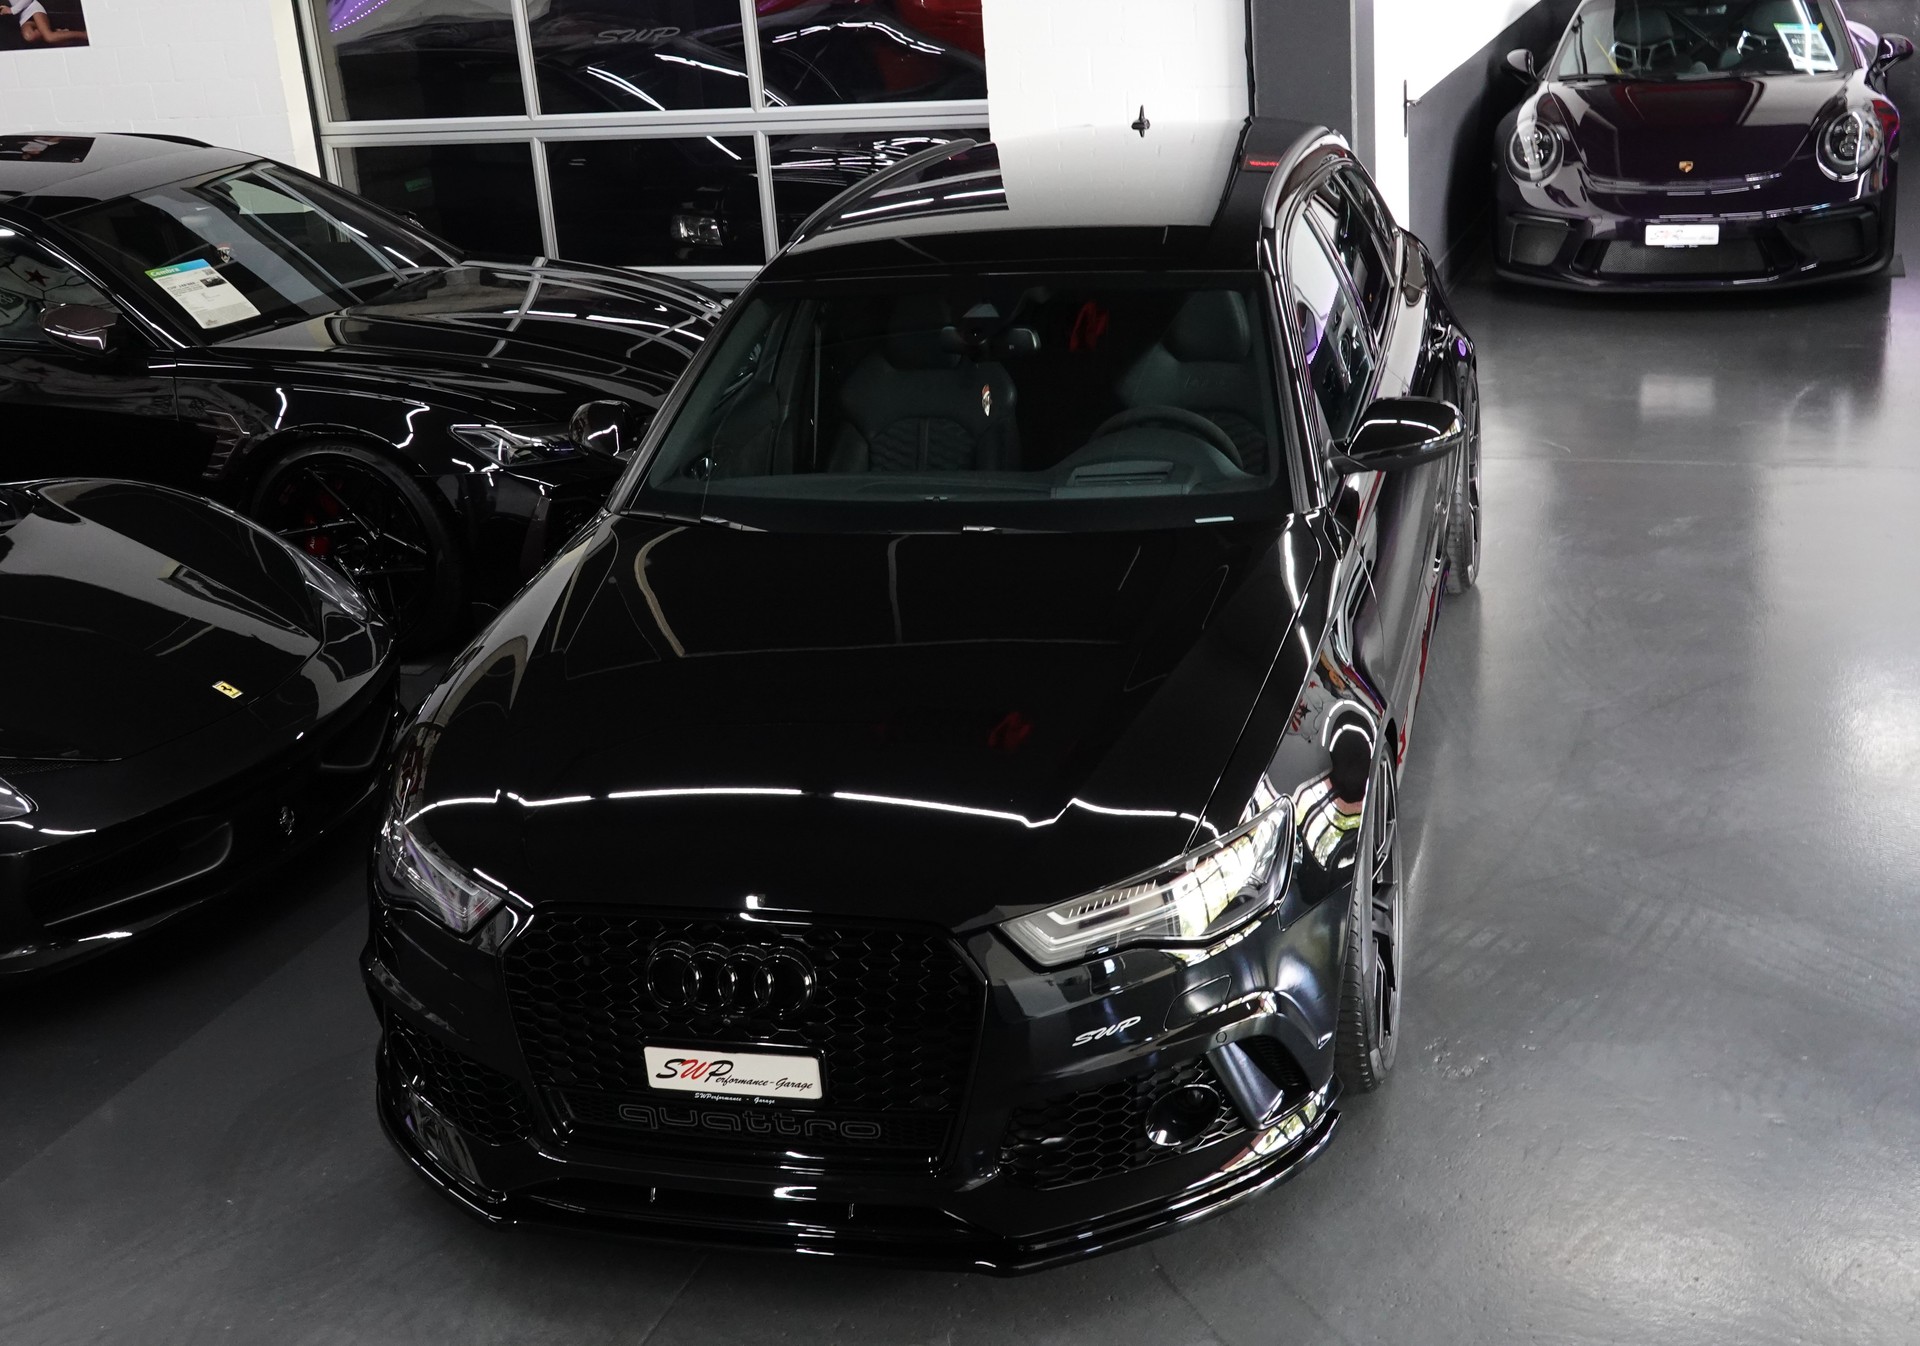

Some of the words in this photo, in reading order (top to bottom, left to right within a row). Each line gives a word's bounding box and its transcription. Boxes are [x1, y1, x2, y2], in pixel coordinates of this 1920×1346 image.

[594, 27, 681, 44] SWP
[1072, 1016, 1142, 1047] SWP
[694, 1092, 743, 1103] SWPerformance
[754, 1096, 776, 1105] Garage
[618, 1103, 881, 1139] quattro
